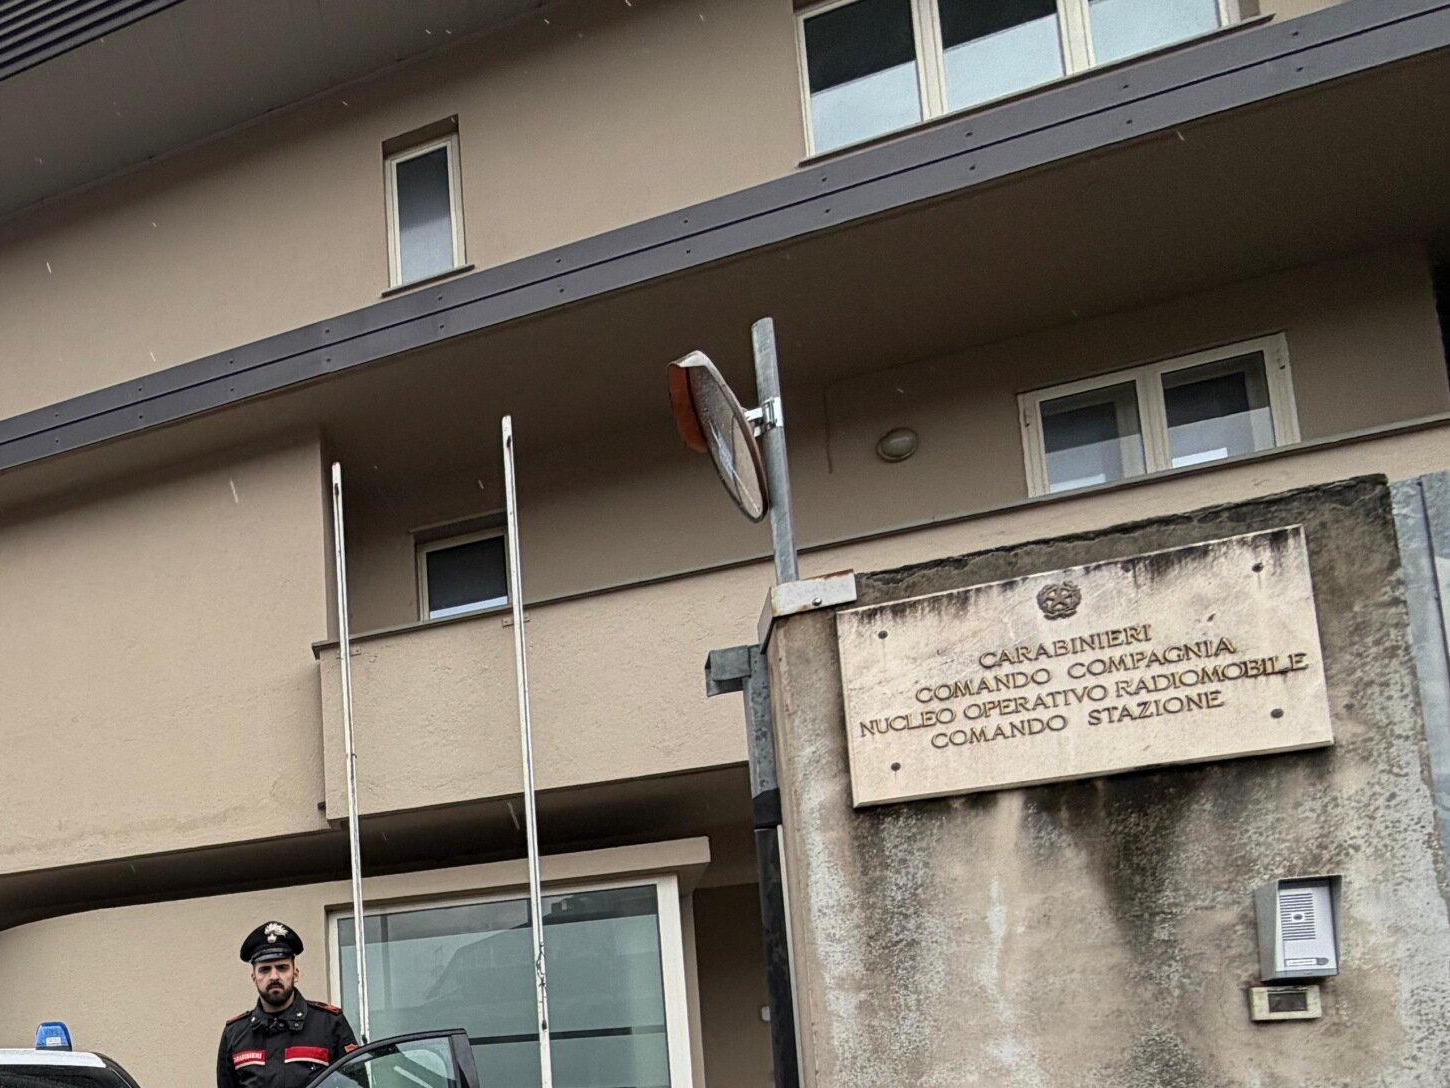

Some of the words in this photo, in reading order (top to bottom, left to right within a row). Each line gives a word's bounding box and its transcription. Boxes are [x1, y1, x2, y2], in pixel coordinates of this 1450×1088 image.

[915, 667, 1053, 704] COMANDO
[1066, 636, 1238, 681] COMPAGNIA
[978, 623, 1153, 670] CARABINIERI
[859, 707, 956, 738] NUCLEO
[963, 683, 1109, 721] OPERATIVO
[1114, 652, 1310, 699] RADIOMOBILE
[930, 713, 1068, 749] COMANDO
[1087, 689, 1226, 727] STAZIONE
